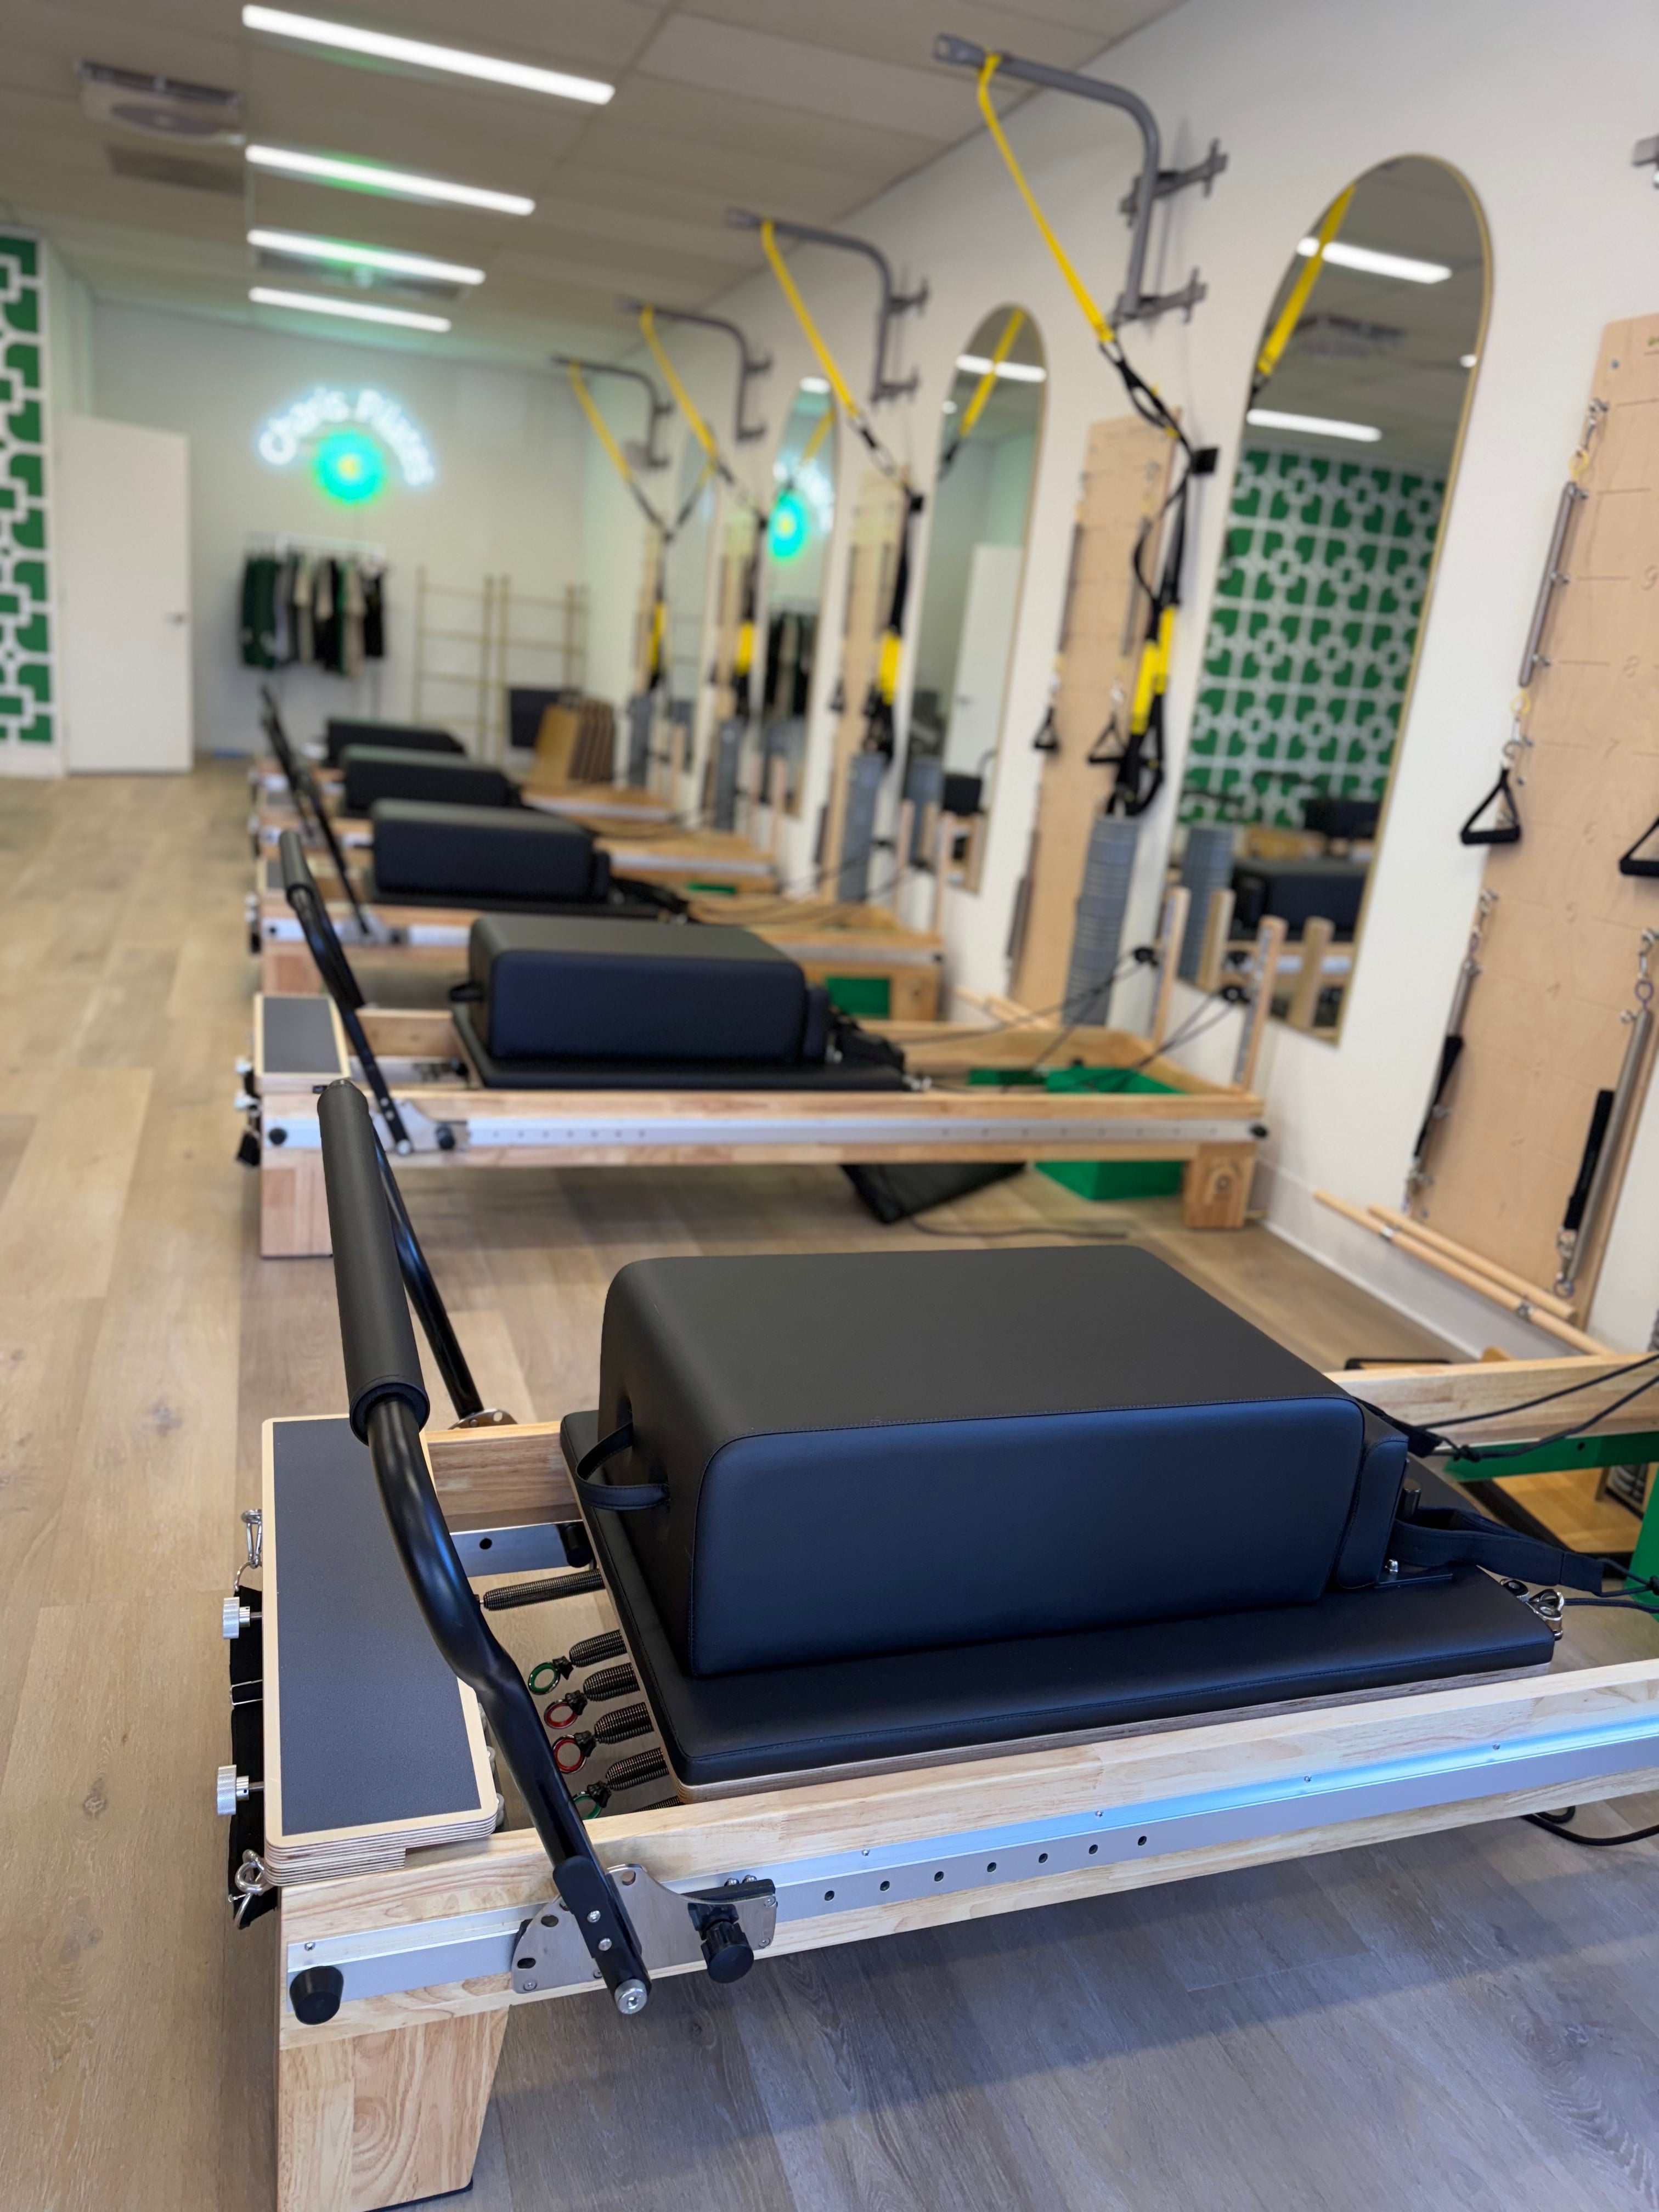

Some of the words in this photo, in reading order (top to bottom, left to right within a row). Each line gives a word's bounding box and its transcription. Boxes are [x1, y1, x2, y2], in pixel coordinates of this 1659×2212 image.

[1643, 564, 1658, 591] 9
[1622, 655, 1640, 679] 8
[1603, 737, 1621, 759] 7
